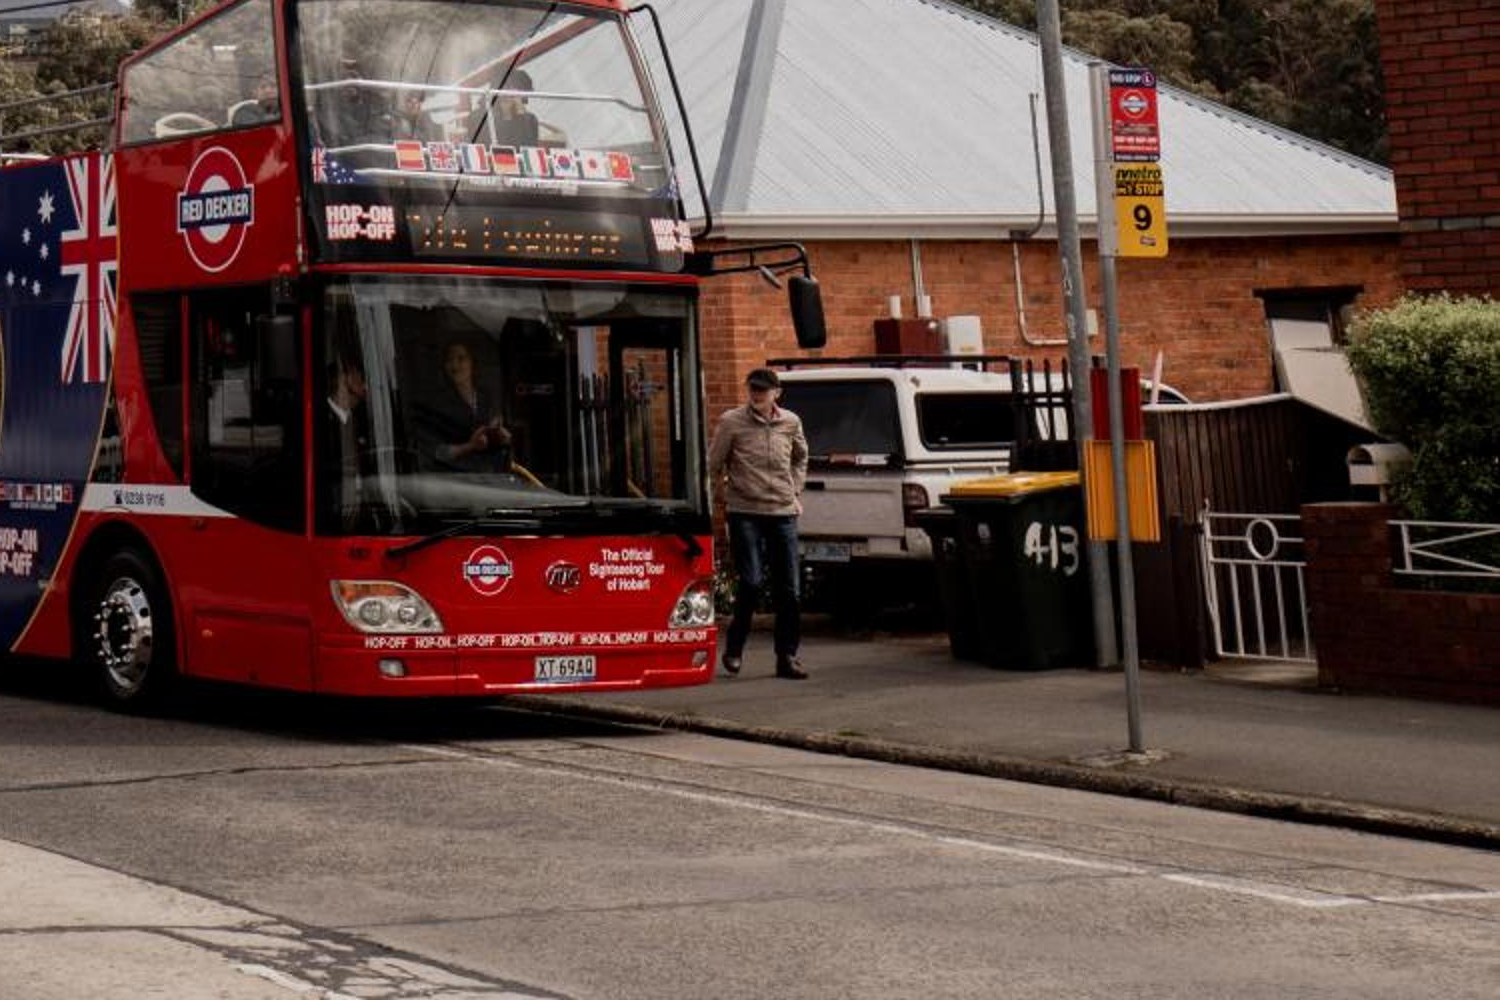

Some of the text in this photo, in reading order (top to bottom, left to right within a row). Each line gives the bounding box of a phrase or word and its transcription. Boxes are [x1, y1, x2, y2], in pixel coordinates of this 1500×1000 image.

[182, 193, 249, 222] RED DECKER
[325, 204, 393, 222] HOP-ON
[1133, 204, 1152, 231] 9
[327, 223, 396, 240] HOP-OFF
[601, 546, 653, 561] The Official
[1023, 521, 1079, 576] 413
[589, 562, 644, 579] Sightseeing
[645, 561, 665, 575] Tour
[607, 578, 651, 591] of Hobart
[365, 636, 408, 649] HOP-OFF
[458, 634, 495, 647] HOP-OFF
[540, 632, 575, 646] HOP-OFF
[617, 631, 648, 645] HOP-OFF
